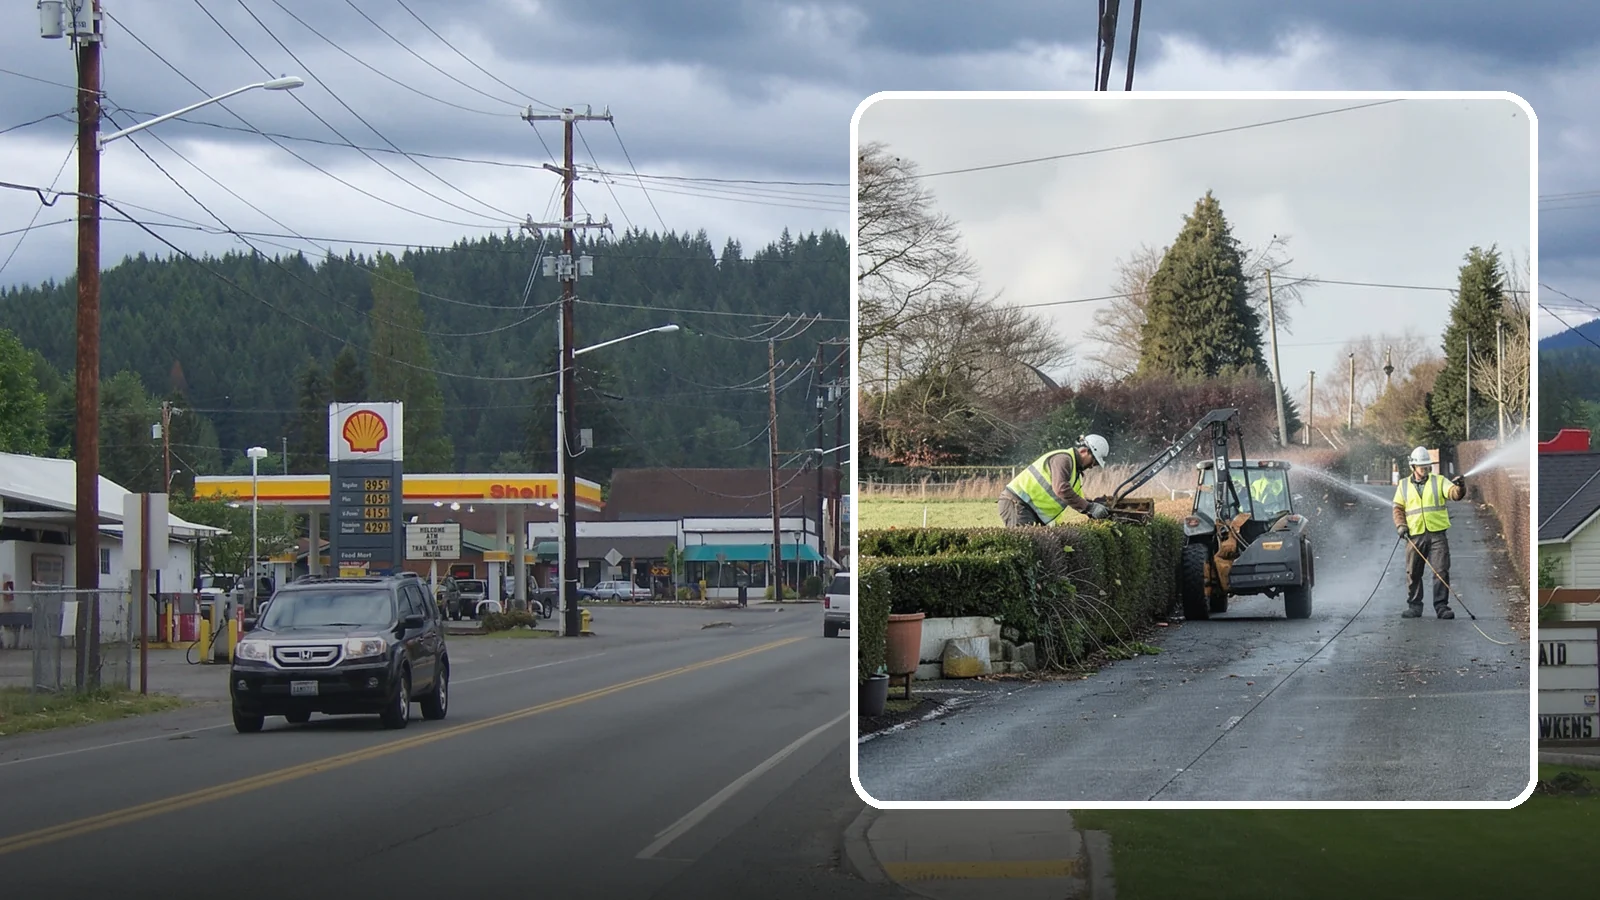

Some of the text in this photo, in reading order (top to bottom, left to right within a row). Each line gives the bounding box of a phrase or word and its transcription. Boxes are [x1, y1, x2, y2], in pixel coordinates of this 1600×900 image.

[366, 480, 383, 490] 395
[490, 484, 547, 499] Shell
[366, 494, 383, 504] 405
[366, 508, 383, 518] 415
[366, 522, 383, 533] 429
